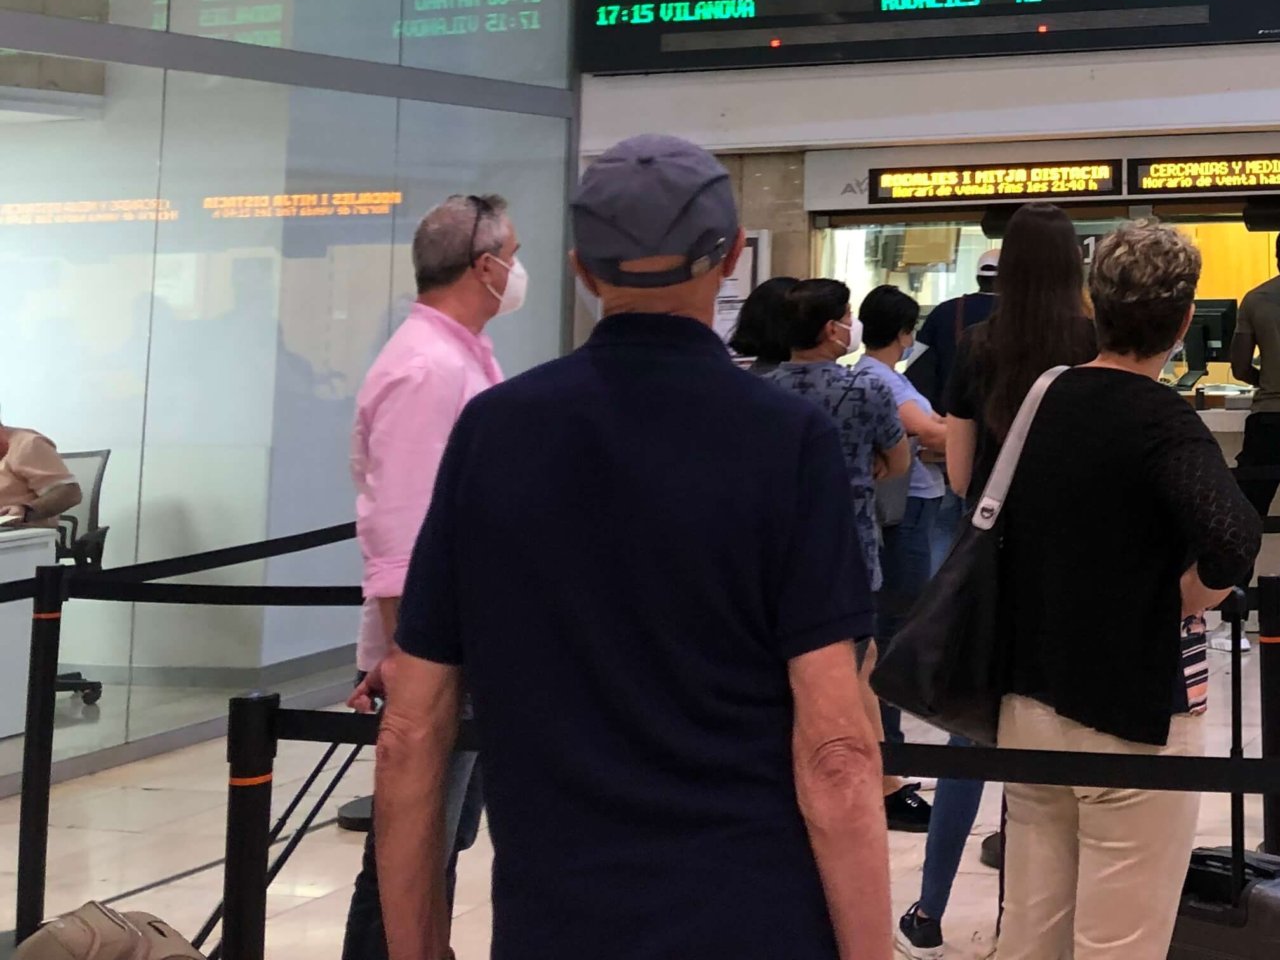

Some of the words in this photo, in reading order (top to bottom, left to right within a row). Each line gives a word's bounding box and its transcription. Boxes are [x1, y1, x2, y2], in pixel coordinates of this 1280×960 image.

[596, 4, 654, 26] 17:15
[660, 0, 756, 22] VILANOVA
[880, 171, 959, 187] RODALIES
[962, 171, 972, 184] I
[975, 168, 1027, 184] MITJA
[1150, 161, 1229, 177] CERCANIAS
[1231, 161, 1242, 174] Y
[1142, 176, 1192, 189] Horario
[1196, 175, 1212, 187] de
[1215, 173, 1257, 187] venta
[1083, 236, 1095, 263] 1
